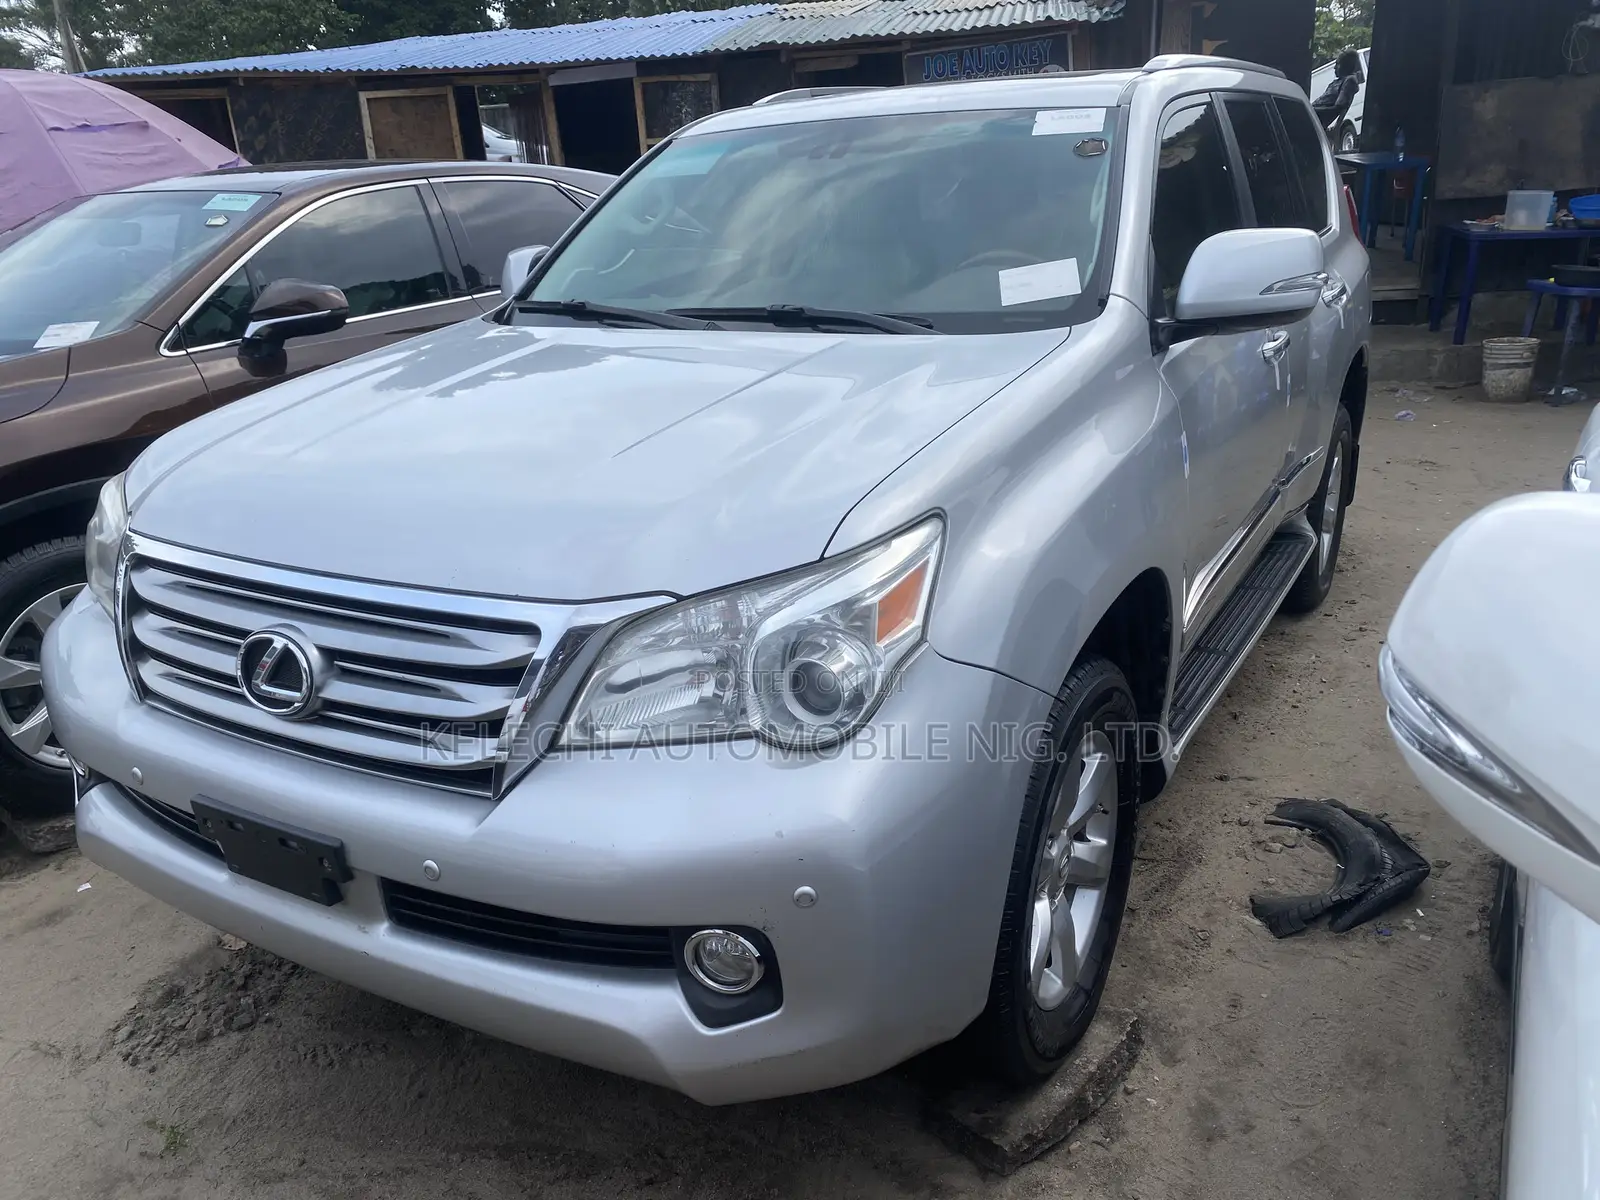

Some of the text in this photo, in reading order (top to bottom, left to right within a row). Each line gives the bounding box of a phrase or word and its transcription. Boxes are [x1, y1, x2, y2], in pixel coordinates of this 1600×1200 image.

[923, 40, 1052, 81] JOE AUTO KEY
